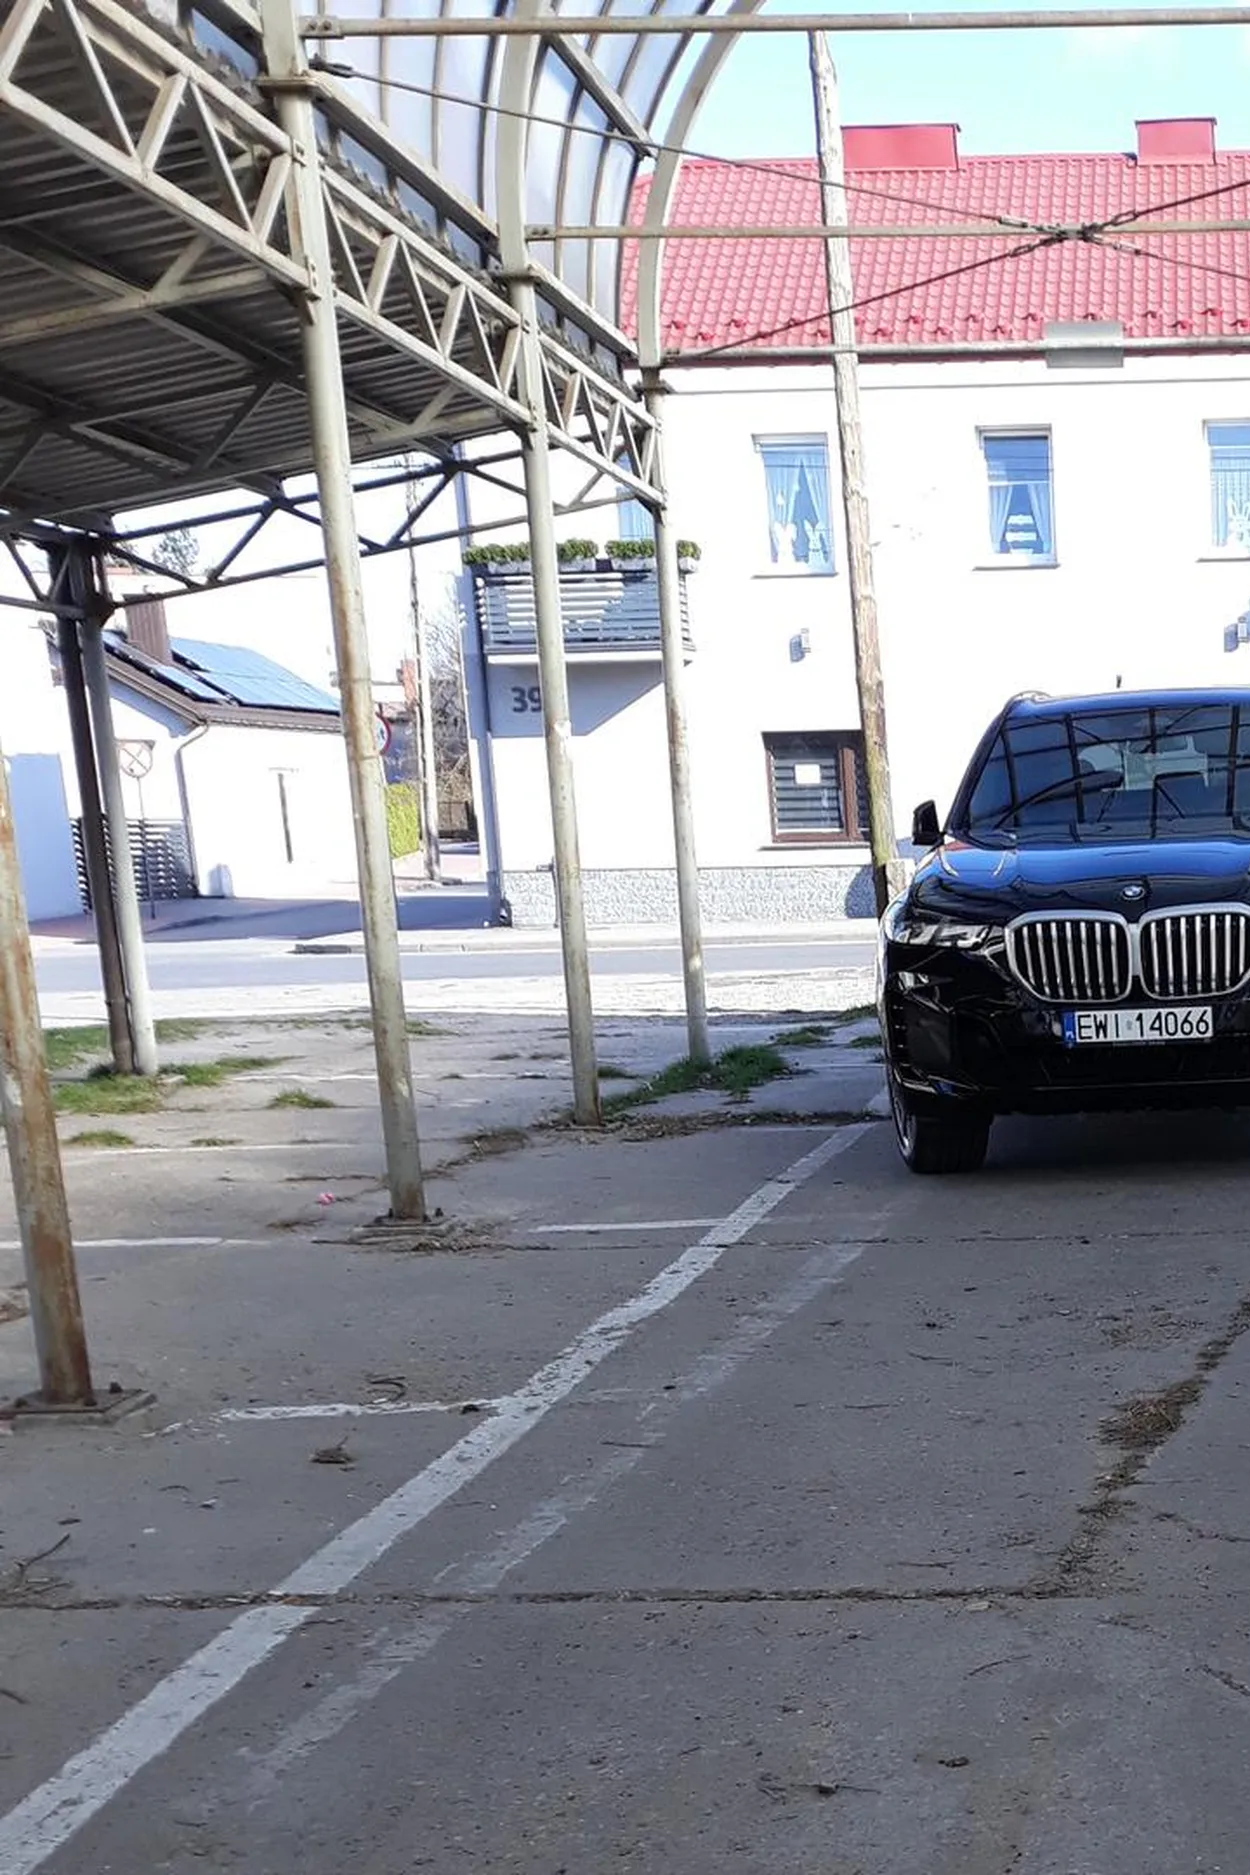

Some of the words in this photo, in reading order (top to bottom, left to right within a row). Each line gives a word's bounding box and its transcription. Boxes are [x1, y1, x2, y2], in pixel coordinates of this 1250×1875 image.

[511, 686, 542, 713] 39
[1077, 1013, 1120, 1040] EWI
[1134, 1010, 1209, 1038] 14066
